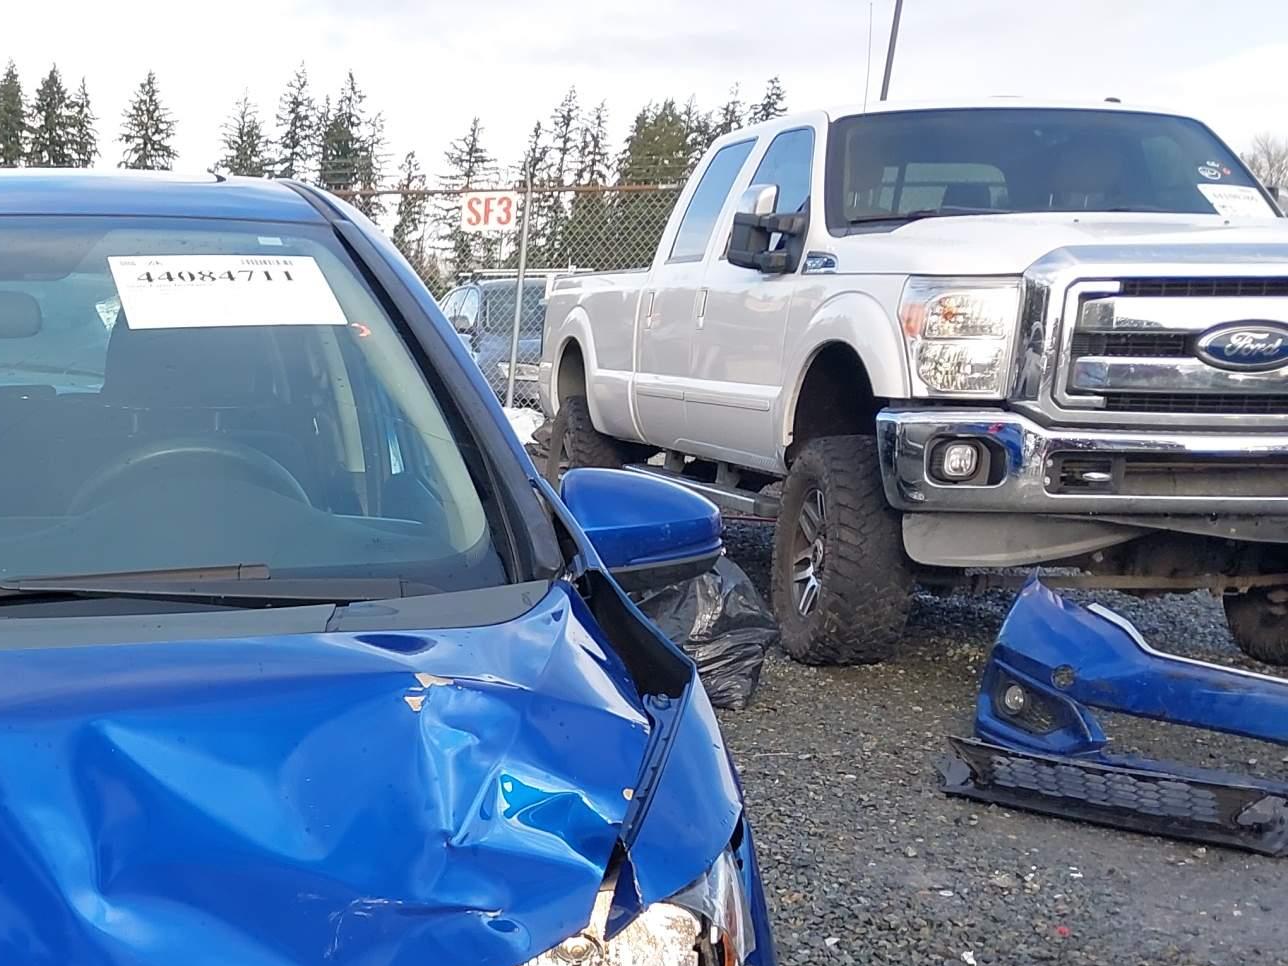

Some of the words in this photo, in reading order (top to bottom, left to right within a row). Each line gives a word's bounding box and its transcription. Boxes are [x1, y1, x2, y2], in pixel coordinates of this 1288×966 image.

[467, 196, 512, 226] SF3
[137, 269, 294, 283] 44084711
[1224, 331, 1283, 357] Ford
